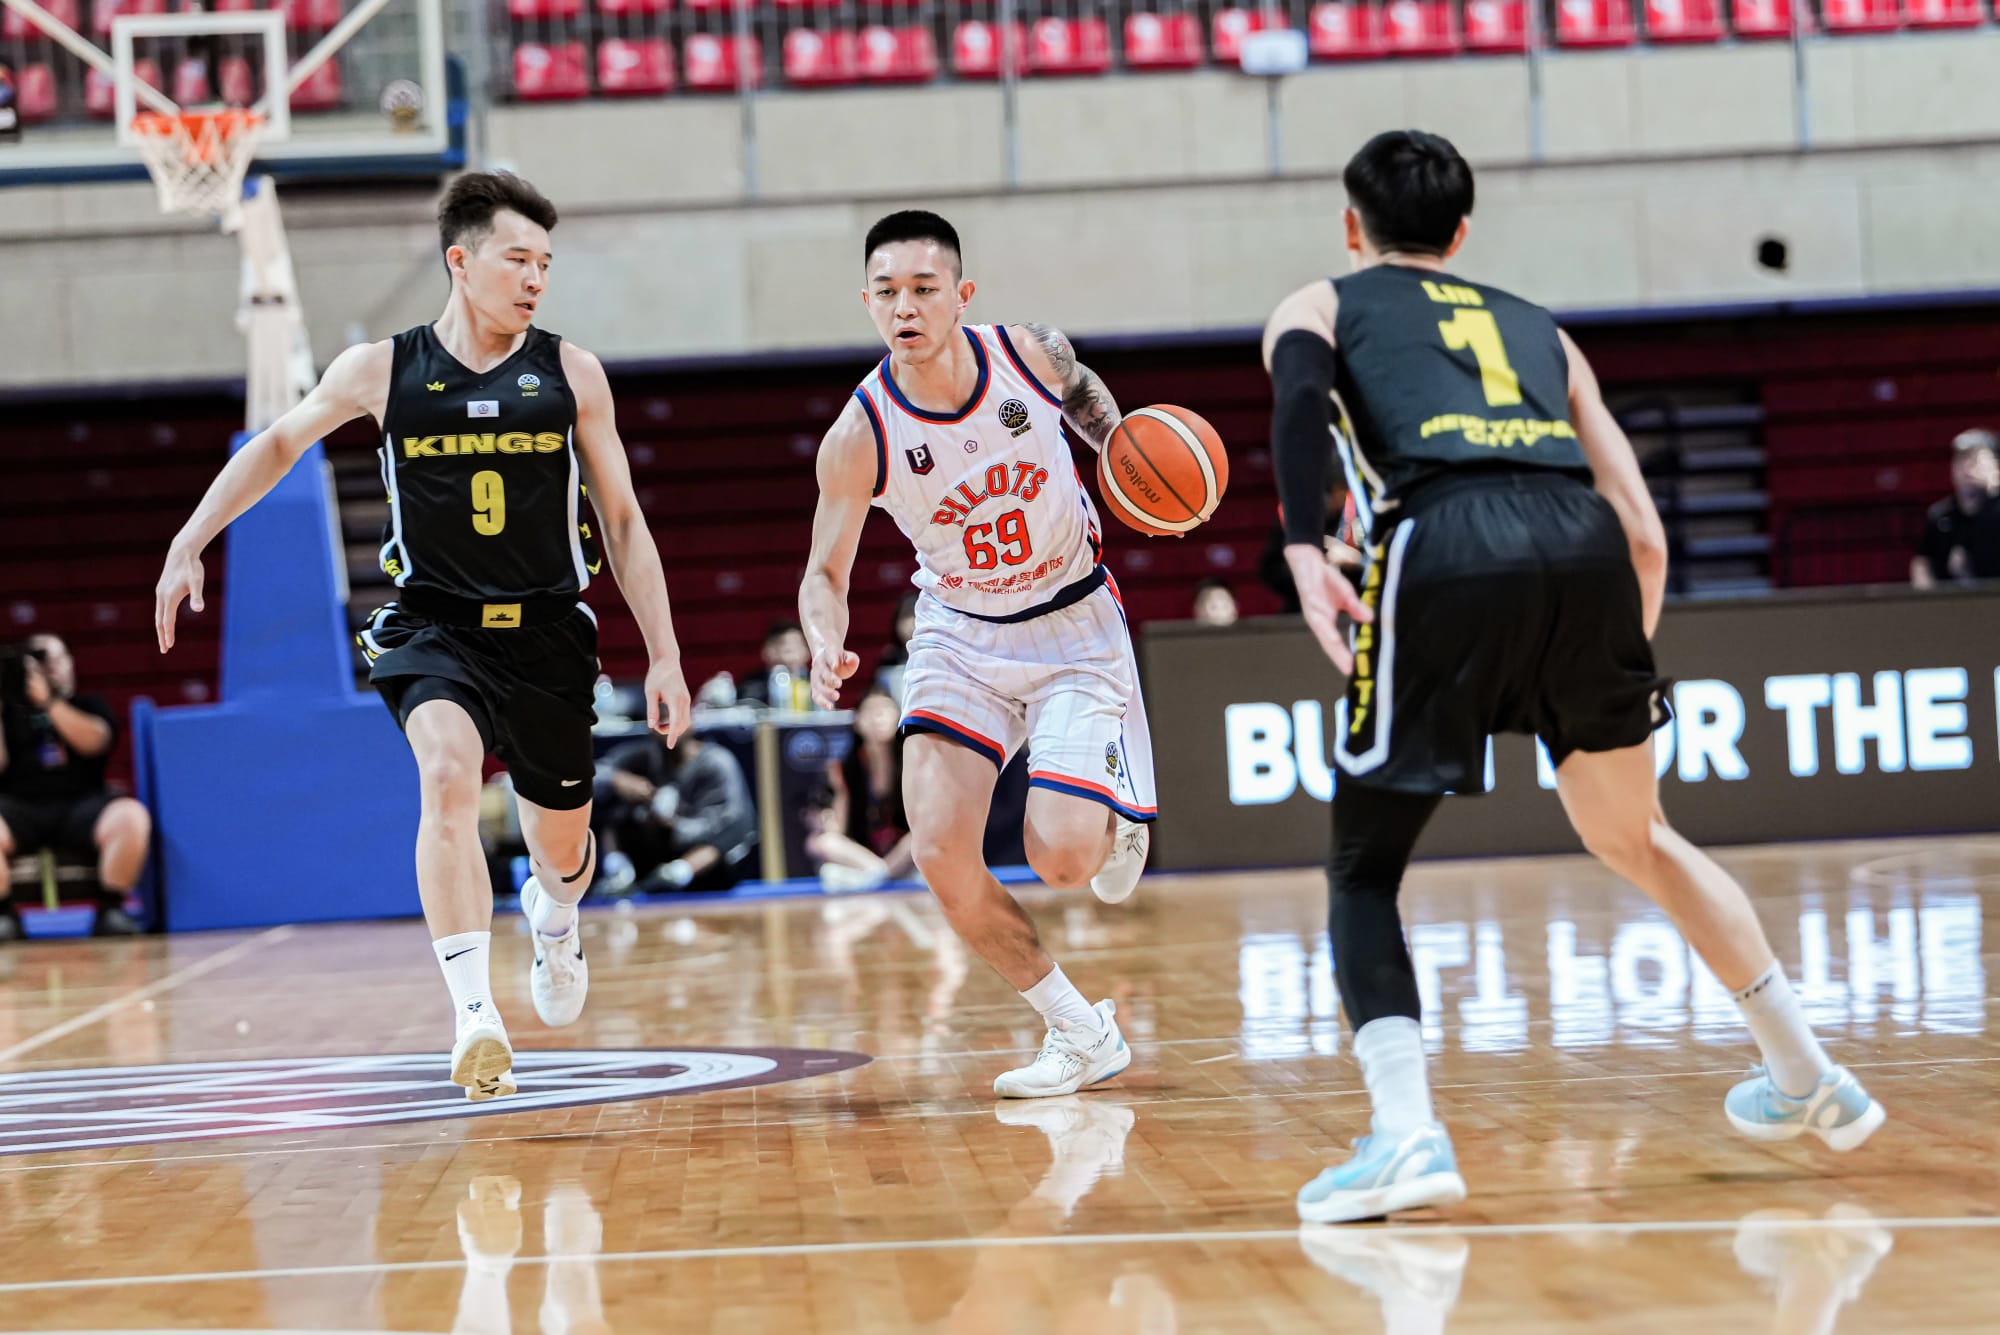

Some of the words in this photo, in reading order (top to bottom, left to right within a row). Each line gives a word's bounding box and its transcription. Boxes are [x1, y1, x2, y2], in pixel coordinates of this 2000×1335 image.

[1438, 308, 1523, 407] 1
[403, 432, 564, 458] KINGS
[471, 470, 505, 536] 9
[930, 461, 1048, 527] PILOTS
[1120, 454, 1162, 503] molten
[963, 508, 1033, 569] 69
[1764, 666, 1974, 778] THE
